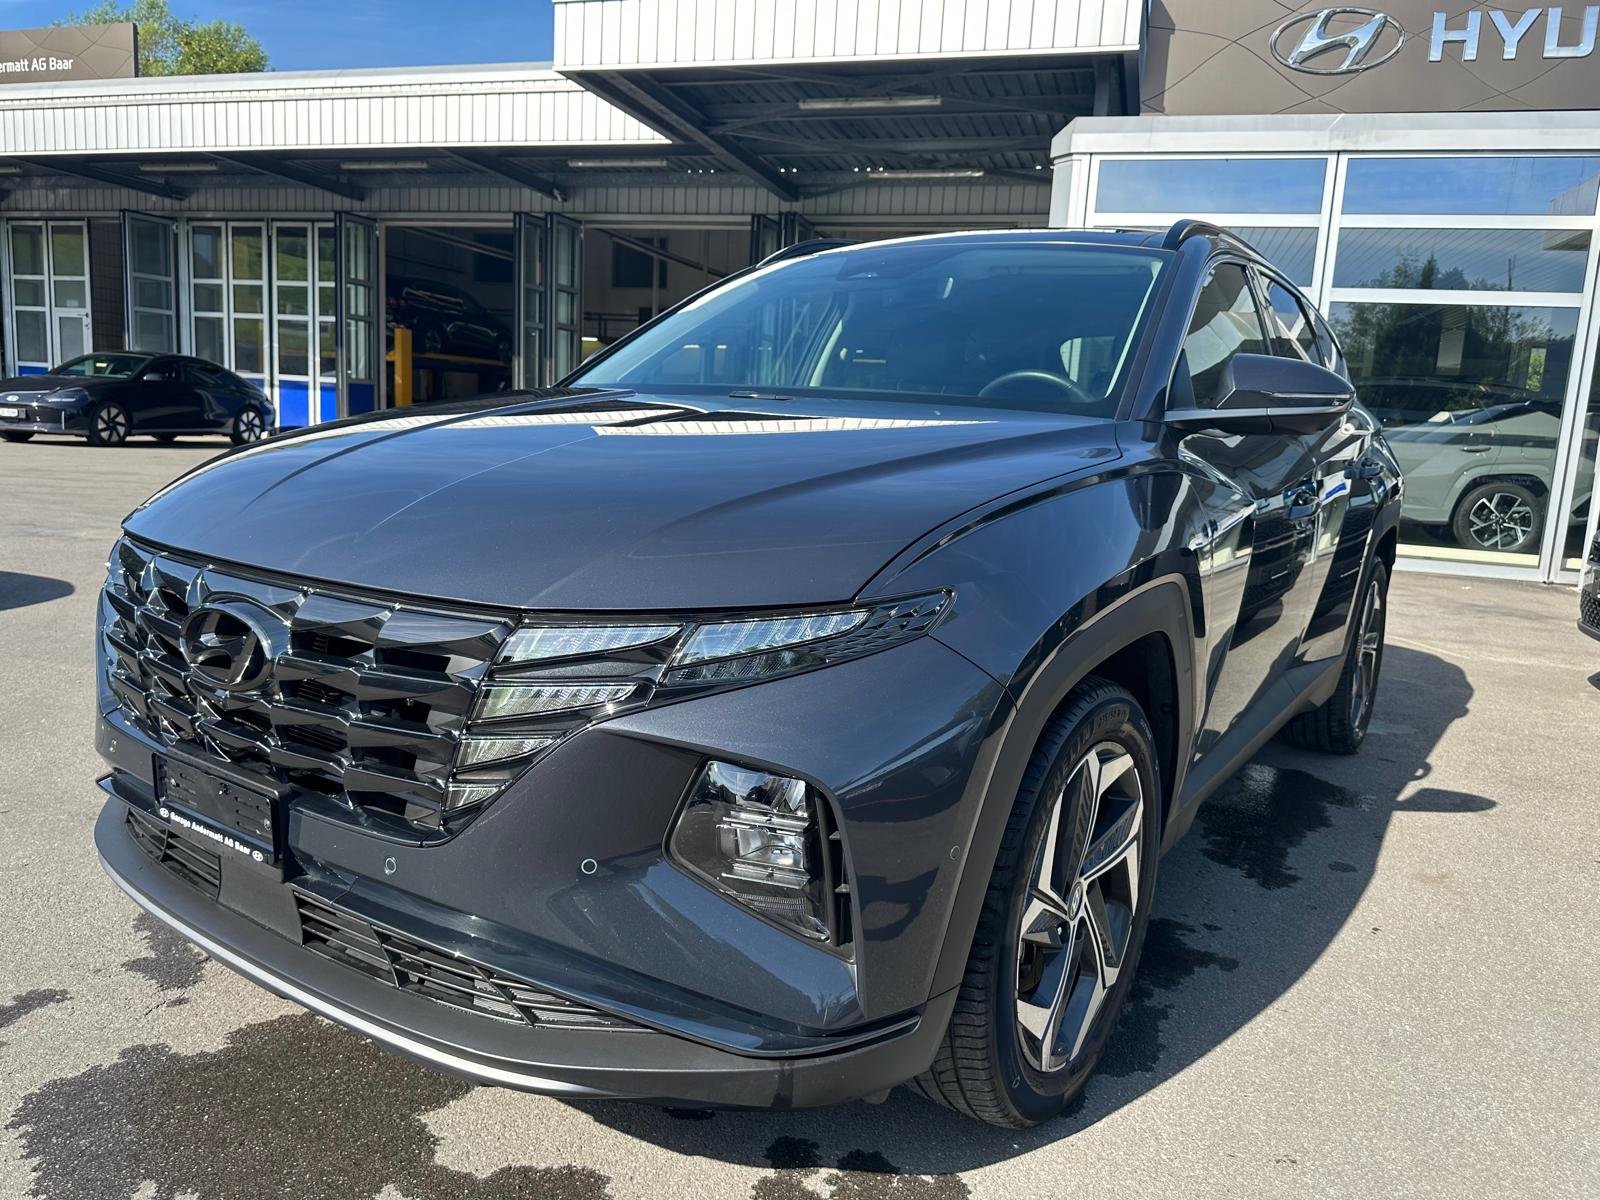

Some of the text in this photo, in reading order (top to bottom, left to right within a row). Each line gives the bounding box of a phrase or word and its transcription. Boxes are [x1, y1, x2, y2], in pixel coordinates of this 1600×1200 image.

[1428, 6, 1600, 62] HYU
[31, 57, 46, 71] AG
[49, 57, 74, 70] Baar
[170, 811, 251, 855] Garage Andermatt AG Baar
